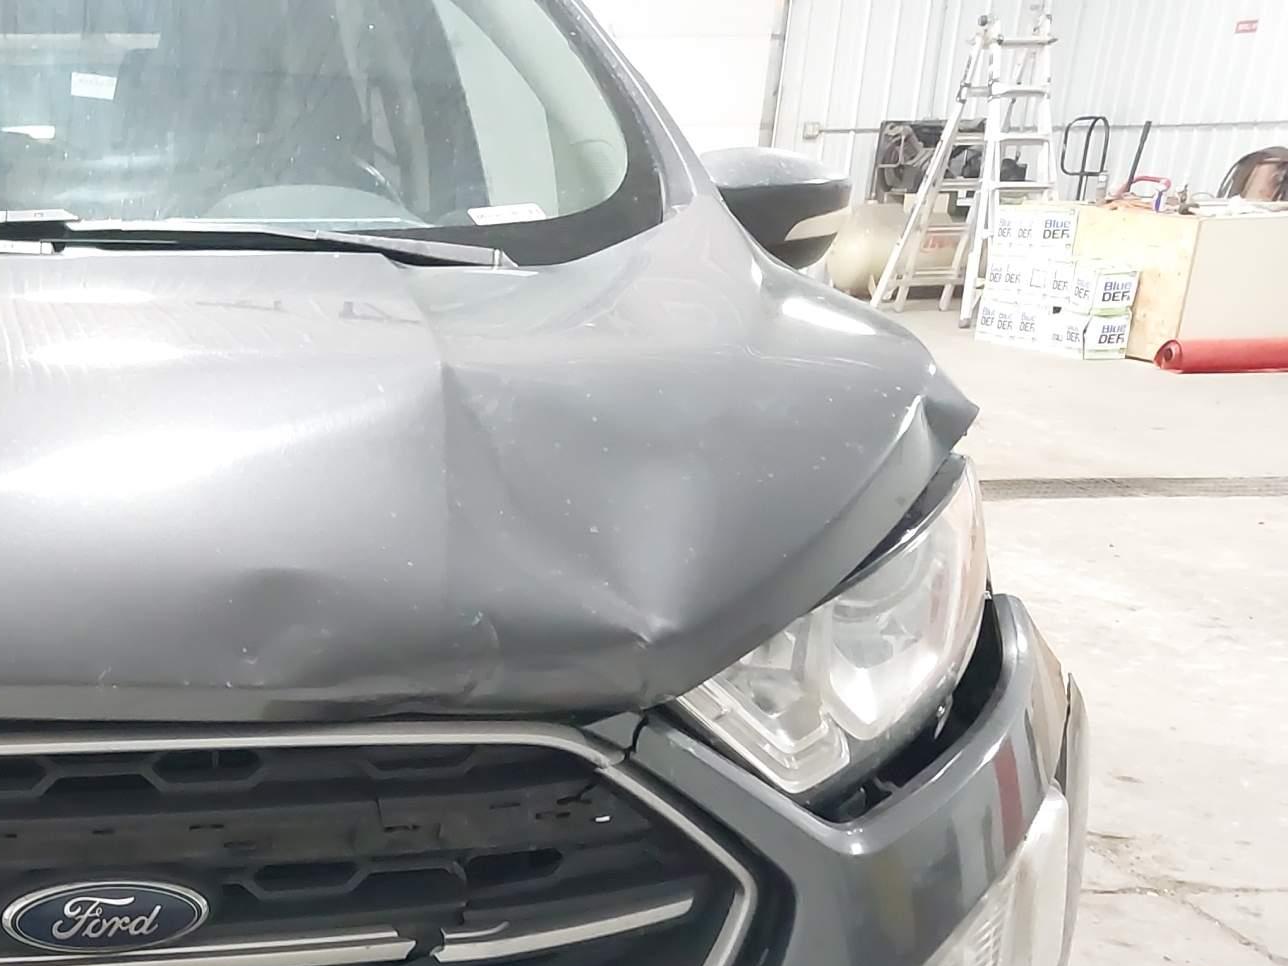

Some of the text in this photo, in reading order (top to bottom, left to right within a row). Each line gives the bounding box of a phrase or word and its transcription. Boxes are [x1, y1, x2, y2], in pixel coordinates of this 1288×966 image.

[1044, 219, 1071, 228] Blue
[1042, 229, 1070, 239] DEF
[1104, 281, 1132, 291] Blue
[1101, 291, 1130, 302] DEF
[1101, 324, 1127, 334] Blue
[1098, 333, 1125, 344] DEF
[52, 896, 162, 940] Ford
